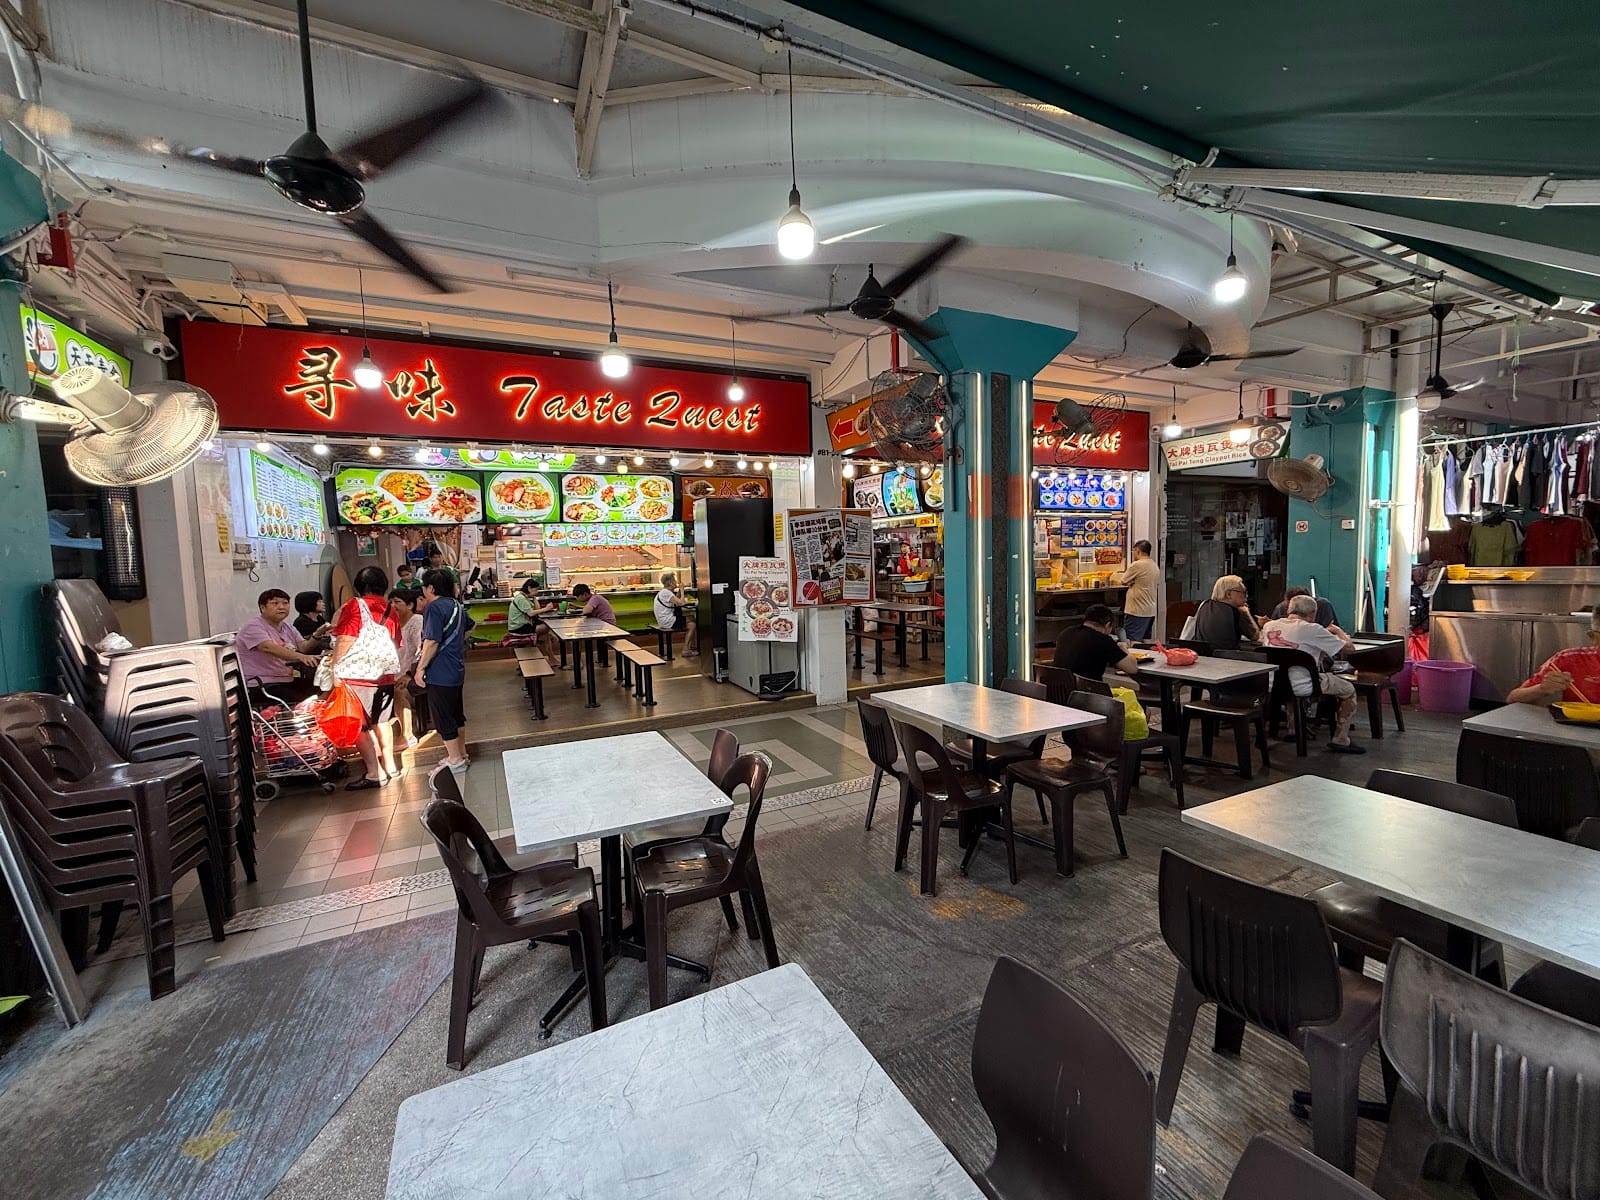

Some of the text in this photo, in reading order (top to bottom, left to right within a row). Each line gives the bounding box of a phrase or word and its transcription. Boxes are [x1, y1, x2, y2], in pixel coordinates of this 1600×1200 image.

[500, 374, 762, 433] Taste Quest
[1205, 454, 1231, 463] Claypot
